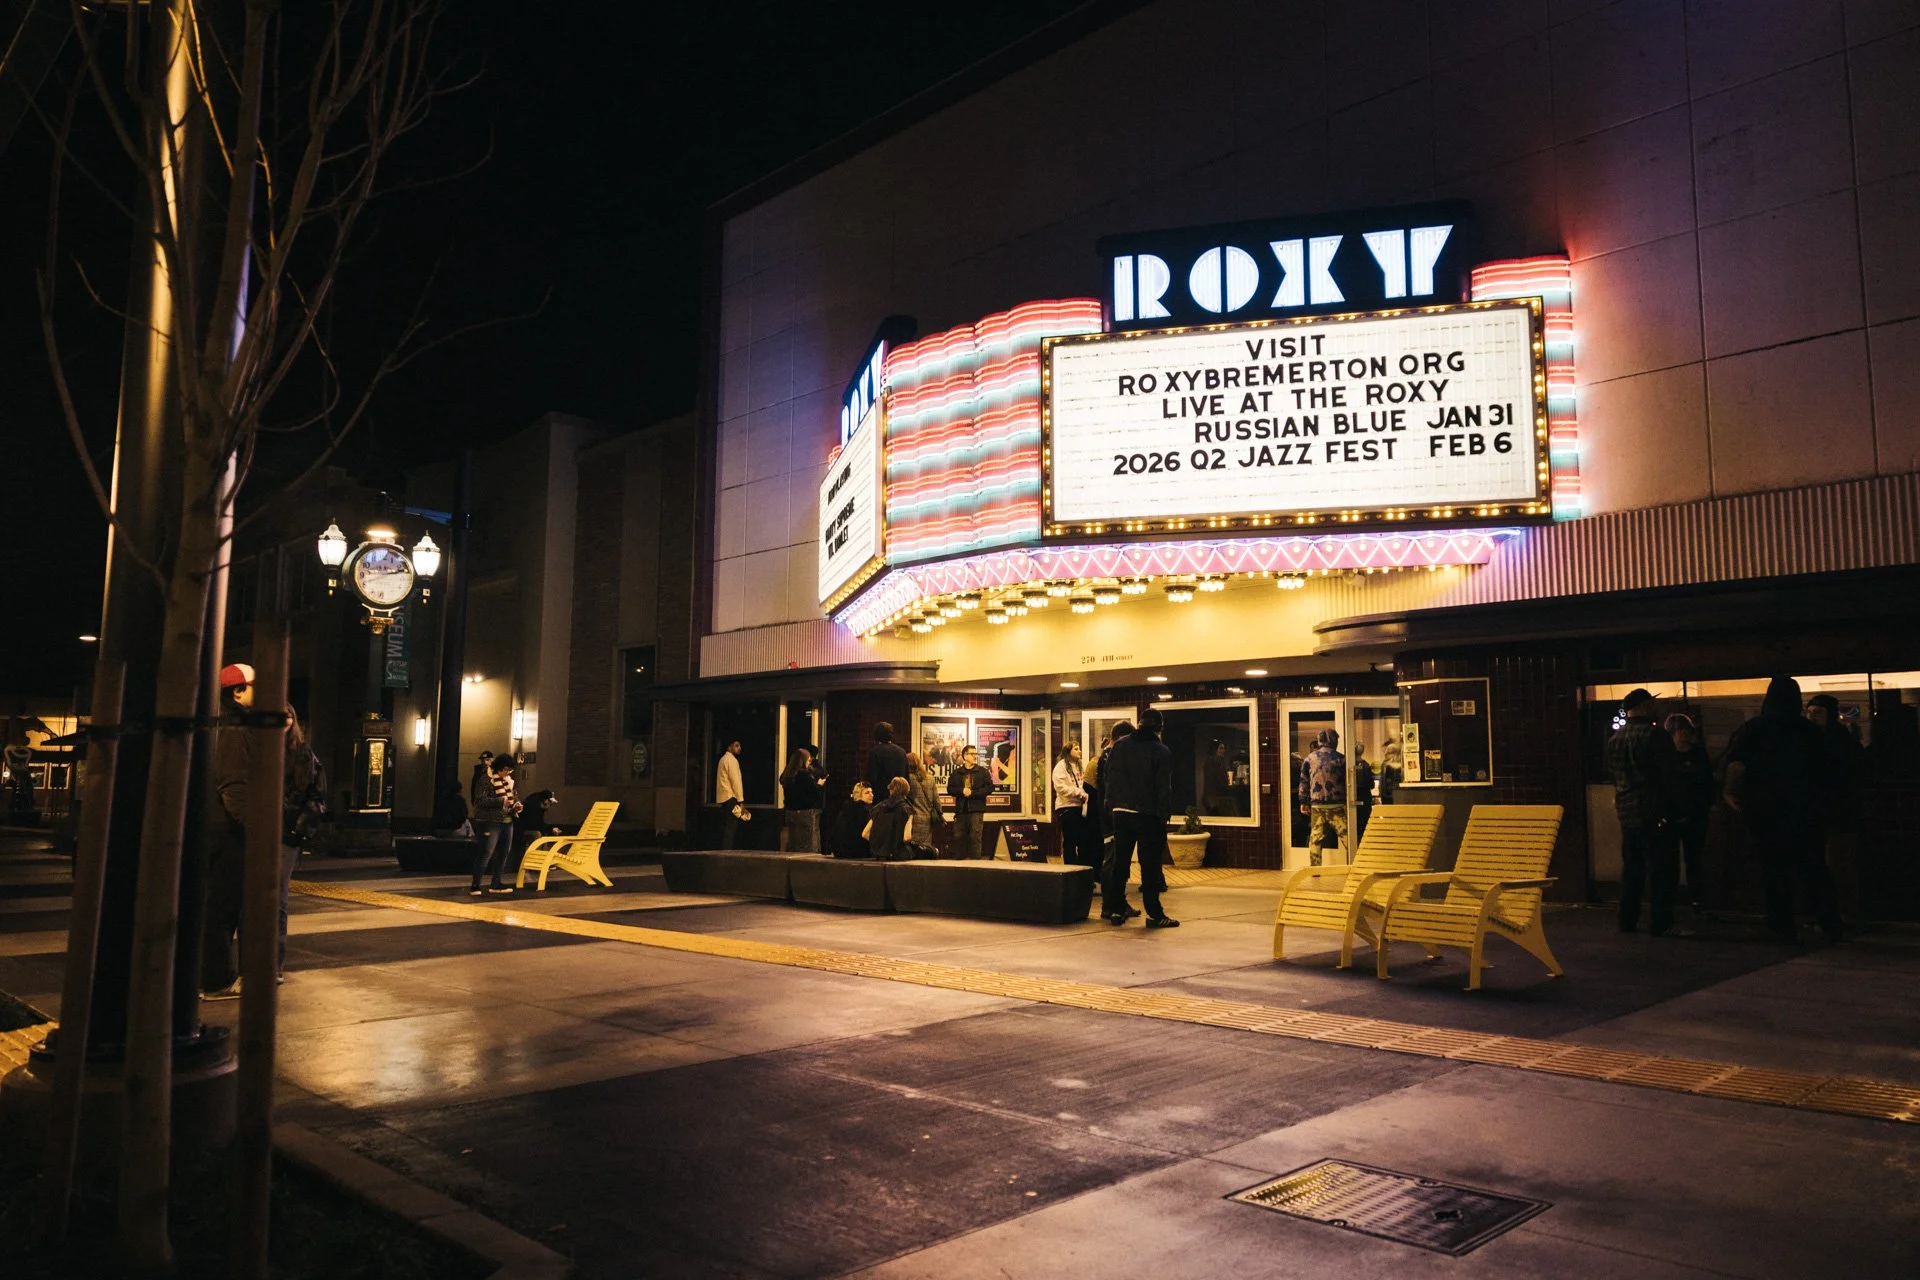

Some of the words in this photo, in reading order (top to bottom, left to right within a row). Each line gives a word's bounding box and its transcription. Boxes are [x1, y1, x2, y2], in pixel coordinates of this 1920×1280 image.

[1114, 225, 1453, 321] ROXY
[1246, 334, 1326, 360] VISIT
[1399, 350, 1465, 376] ORG
[1163, 394, 1225, 419] LIVE
[1240, 390, 1273, 414] AT
[1290, 385, 1347, 410] THE
[1366, 378, 1450, 406] ROXY
[1194, 414, 1320, 444] RUSSIAN
[1333, 409, 1407, 435] BLUE
[1426, 404, 1482, 430] JAN
[1488, 402, 1514, 426] 31
[1113, 451, 1181, 476] 2026
[1190, 448, 1226, 471] Q2
[1237, 442, 1313, 469] JAZZ
[1325, 437, 1398, 464] FEST
[1429, 432, 1486, 458] FEB
[1493, 431, 1513, 454] 6
[1081, 655, 1095, 664] 270
